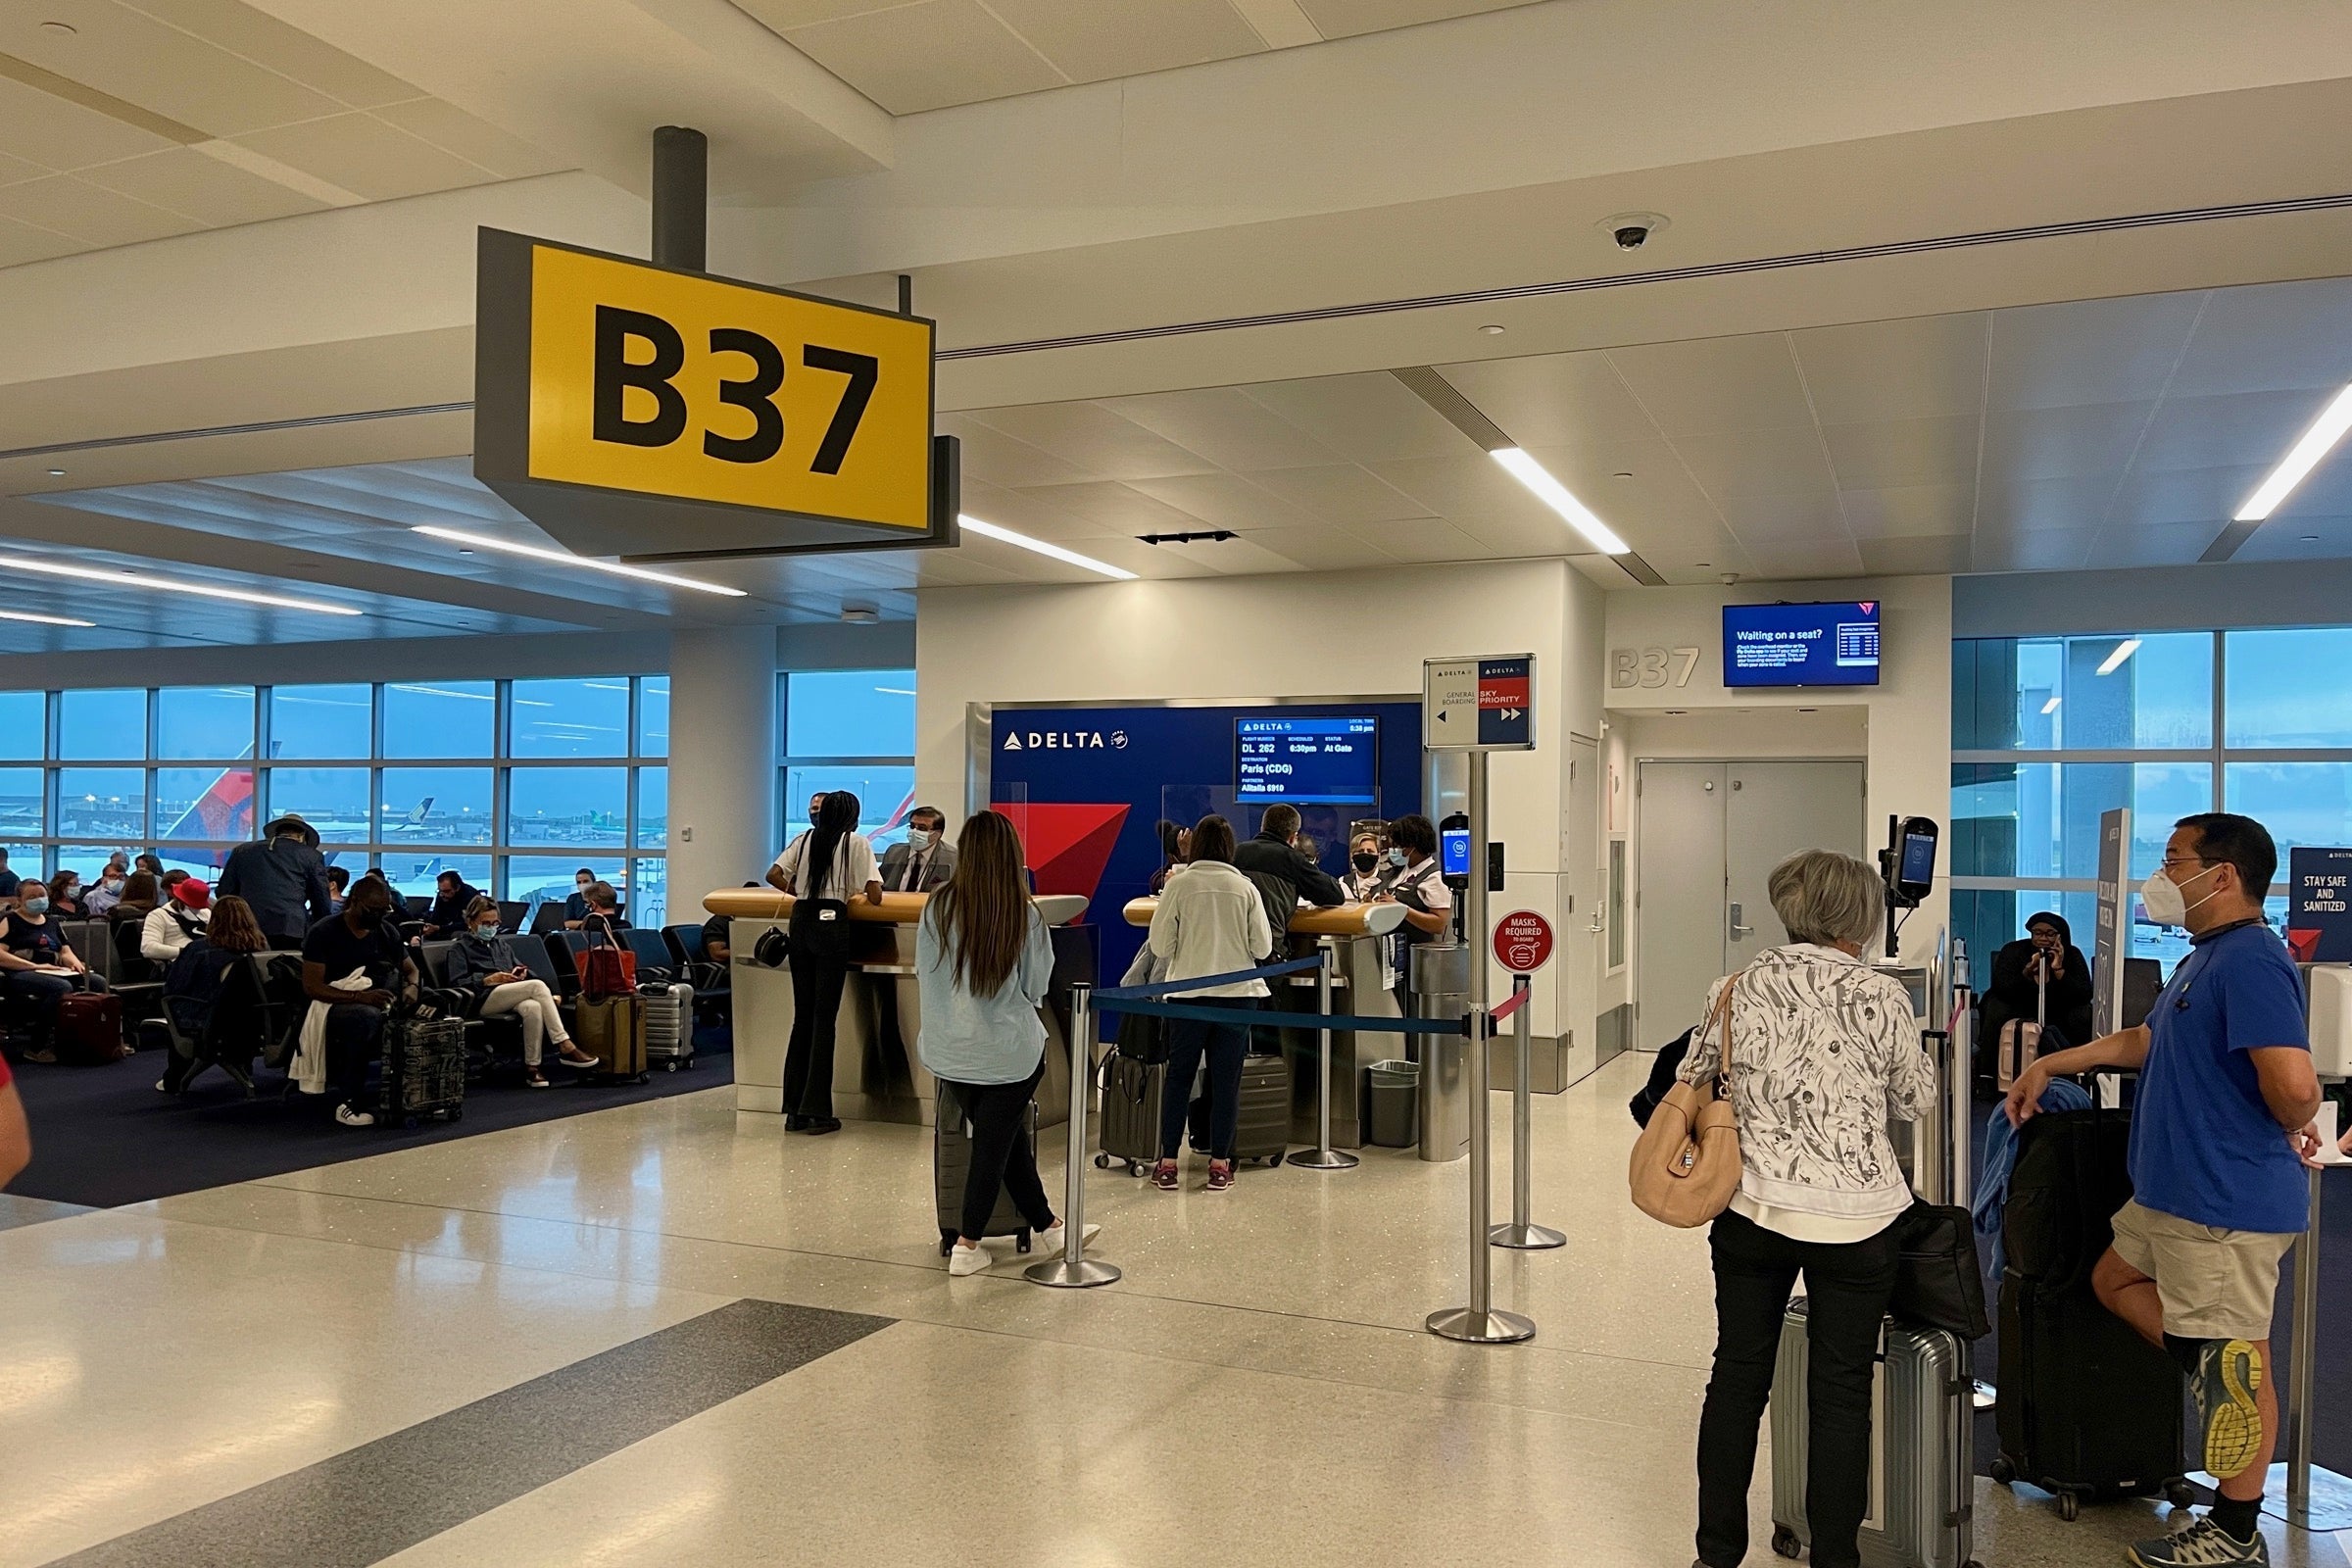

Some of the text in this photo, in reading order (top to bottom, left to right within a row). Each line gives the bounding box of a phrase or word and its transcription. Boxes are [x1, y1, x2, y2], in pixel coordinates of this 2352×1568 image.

[592, 304, 879, 476] B37
[1738, 631, 1774, 641] Waiting
[1797, 629, 1823, 639] seat?
[1611, 647, 1699, 689] B37
[1028, 732, 1103, 748] DELTA
[1242, 743, 1275, 753] DL 262
[1324, 744, 1352, 753] At Gate
[1242, 764, 1293, 775] Paris (CDG)
[2304, 876, 2347, 886] STAY SAFE
[2316, 889, 2334, 899] AND
[2303, 901, 2346, 911] SANITIZED
[1505, 927, 1542, 936] REQUIRED
